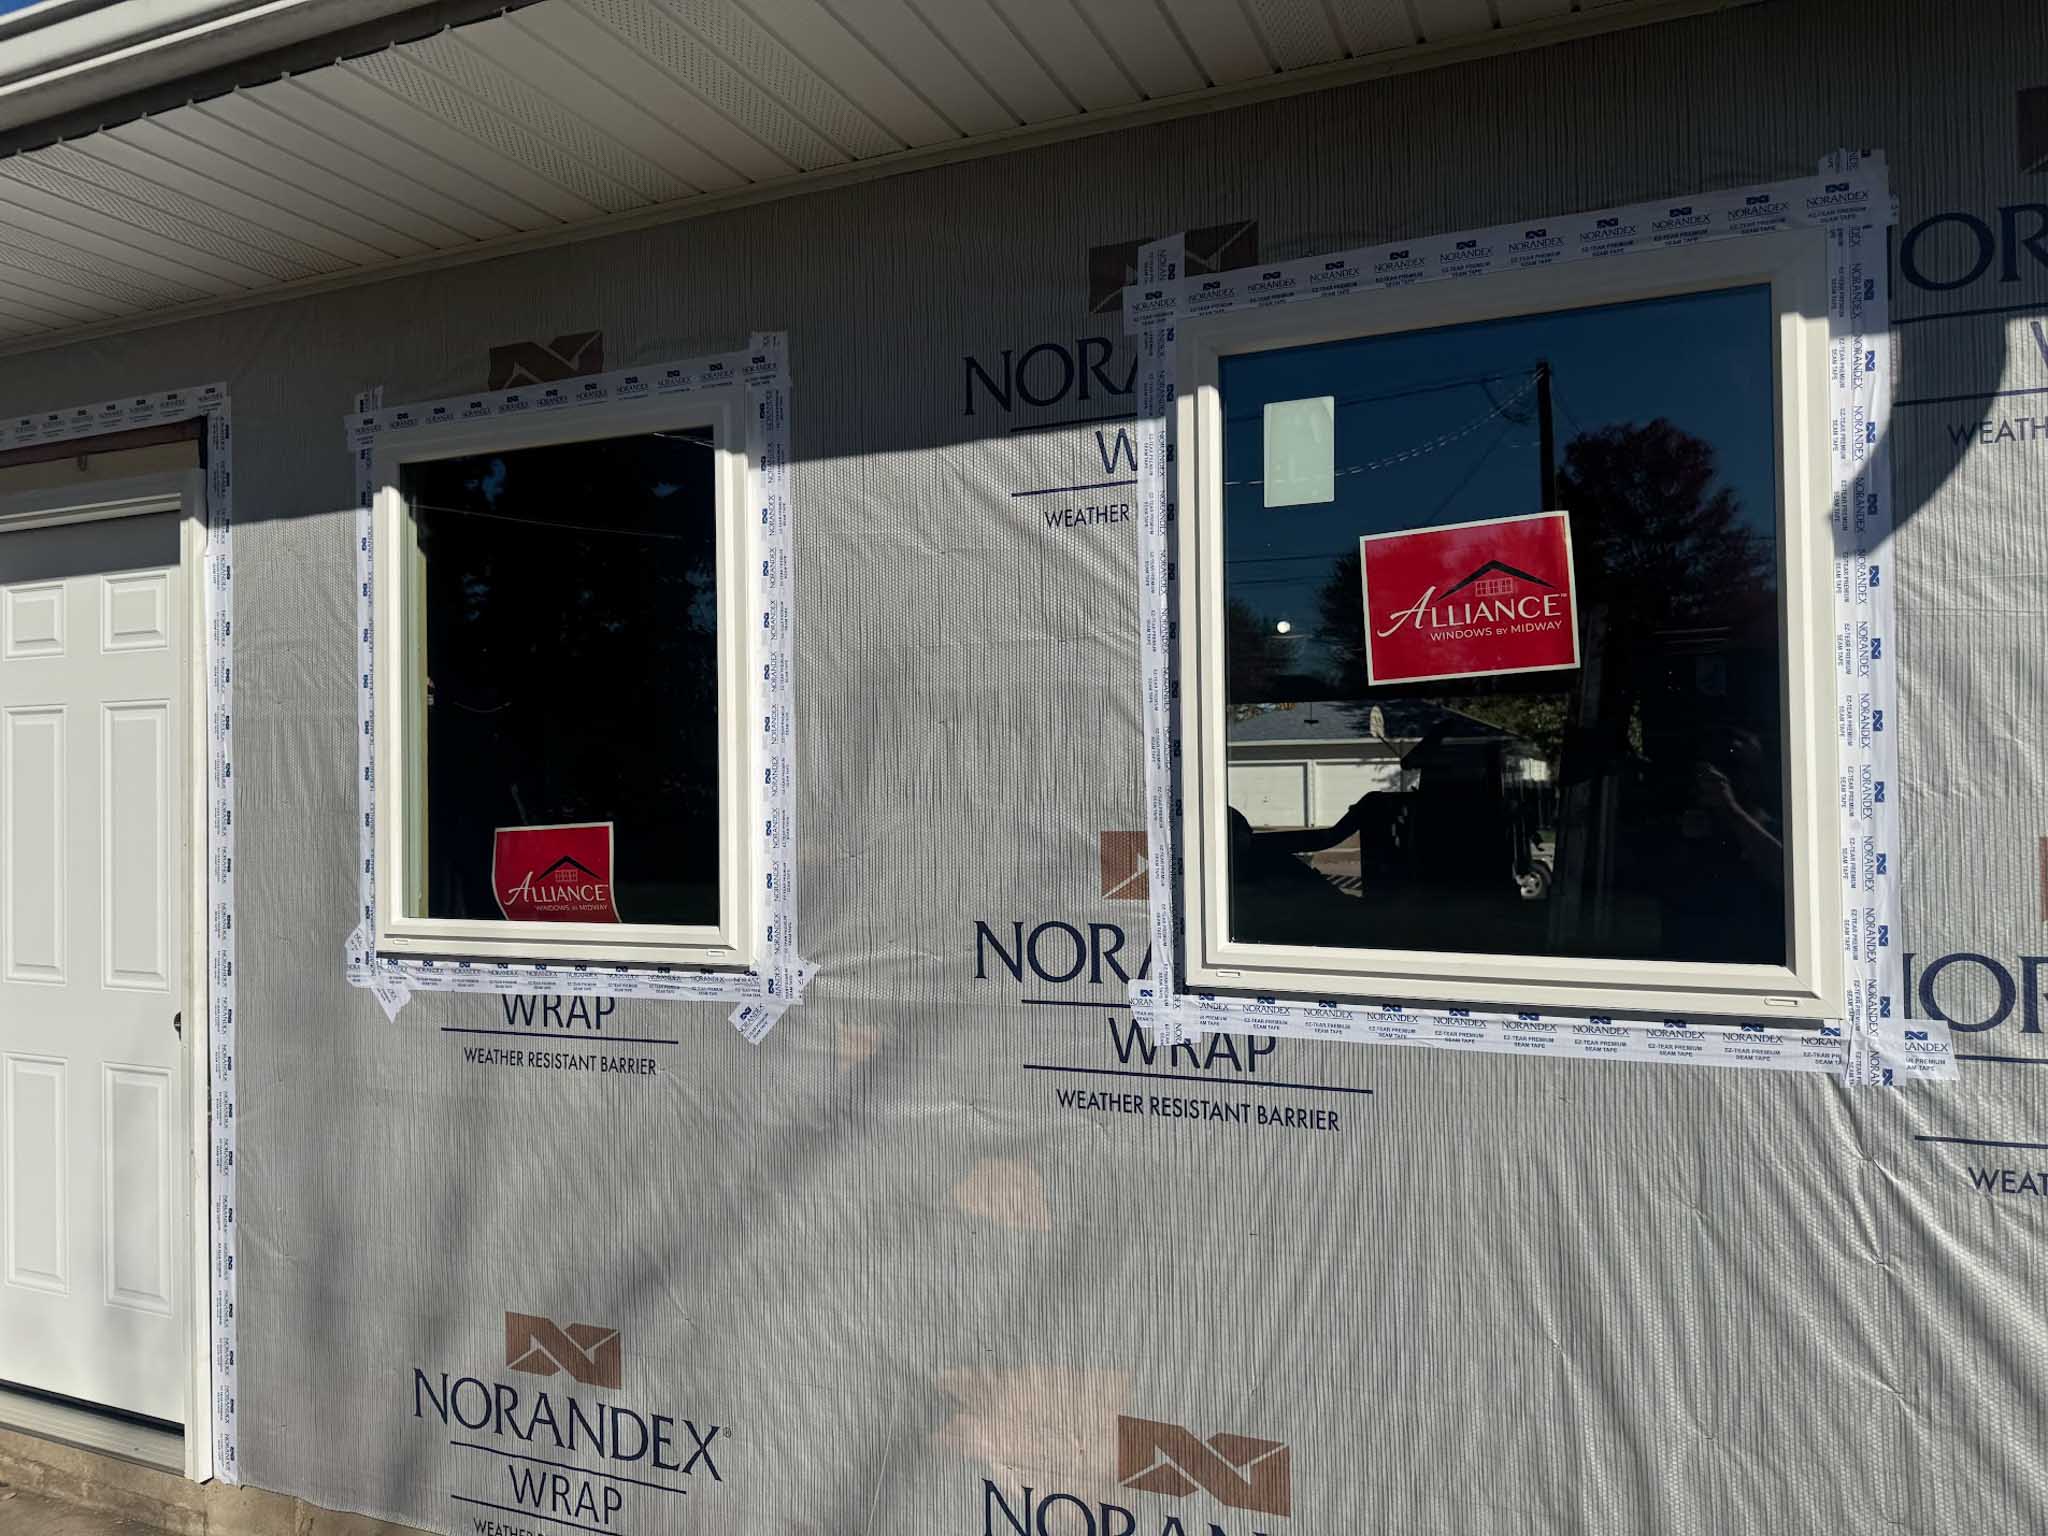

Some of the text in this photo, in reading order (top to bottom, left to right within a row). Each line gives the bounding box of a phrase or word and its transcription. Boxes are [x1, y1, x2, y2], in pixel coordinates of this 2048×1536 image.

[1806, 191, 1869, 206] NORANDEX
[1887, 204, 2048, 301] OR
[961, 337, 1137, 415] NOR
[1853, 336, 1863, 390] NORANDEX
[1854, 406, 1864, 461] NORANDEX
[1045, 504, 1129, 528] WEATHER
[1857, 478, 1866, 532] NORANDEX
[1857, 550, 1867, 604] NORANDEX
[1431, 628, 1492, 641] WINDOWS
[1512, 620, 1562, 634] MIDWAY
[1859, 622, 1868, 677] NORANDEX
[1861, 693, 1870, 748] NORANDEX
[1862, 764, 1872, 820] NORANDEX
[504, 872, 608, 905] ALLIANCE
[1864, 836, 1874, 891] NORANDEX
[974, 920, 1151, 984] NOR
[1865, 907, 1876, 963] NORANDEX
[501, 994, 616, 1030] WRAP
[1243, 1004, 1290, 1014] NORANDEX
[1304, 1008, 1352, 1019] NORANDEX
[1367, 1012, 1418, 1022] NORANDEX
[1433, 1016, 1487, 1028] NORANDEX
[1502, 1020, 1558, 1032] NORANDEX
[1573, 1025, 1628, 1035] NORANDEX
[1647, 1028, 1704, 1039] NORANDEX
[1868, 979, 1878, 1036] NORANDEX
[464, 1048, 656, 1075] WEATHER RESISTANT BARRIER
[1108, 1018, 1277, 1073] WRAP
[1723, 1032, 1783, 1043] NORANDEX
[1056, 1089, 1339, 1131] WEATHER RESISTANT BARRIER
[414, 1367, 722, 1481] NORANDEX
[509, 1465, 622, 1524] WRAP
